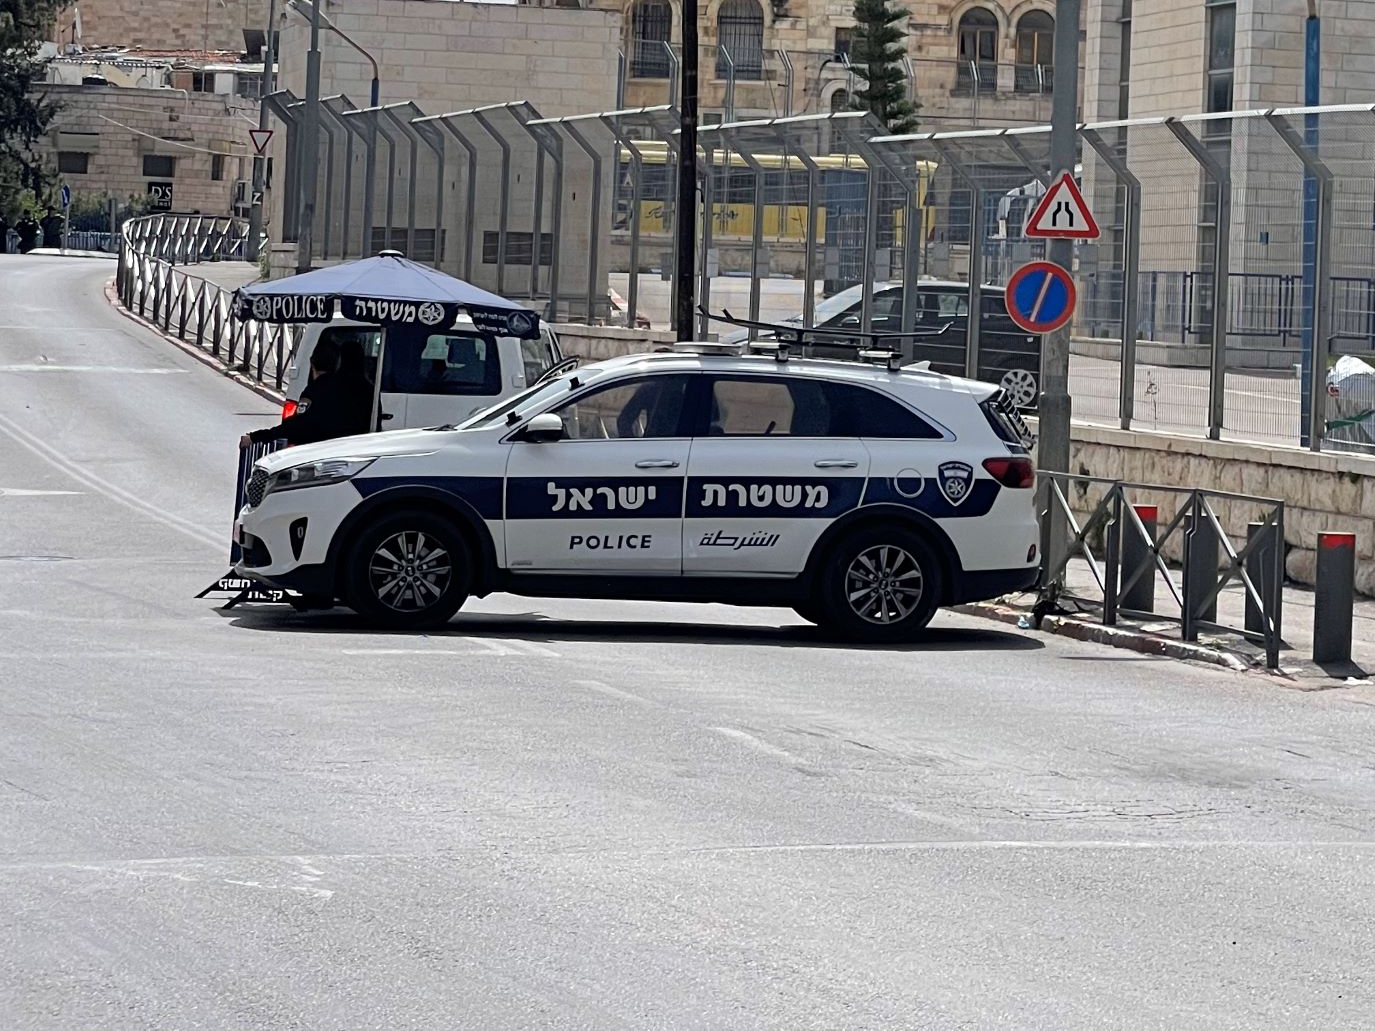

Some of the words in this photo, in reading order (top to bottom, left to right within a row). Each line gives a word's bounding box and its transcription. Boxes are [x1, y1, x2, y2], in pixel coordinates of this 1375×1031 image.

[272, 294, 327, 320] POLICE
[354, 298, 416, 323] משטרה
[547, 481, 657, 512] ישראל
[701, 483, 829, 509] משטרת
[569, 534, 653, 550] POLICE
[698, 530, 781, 551] الشرطة
